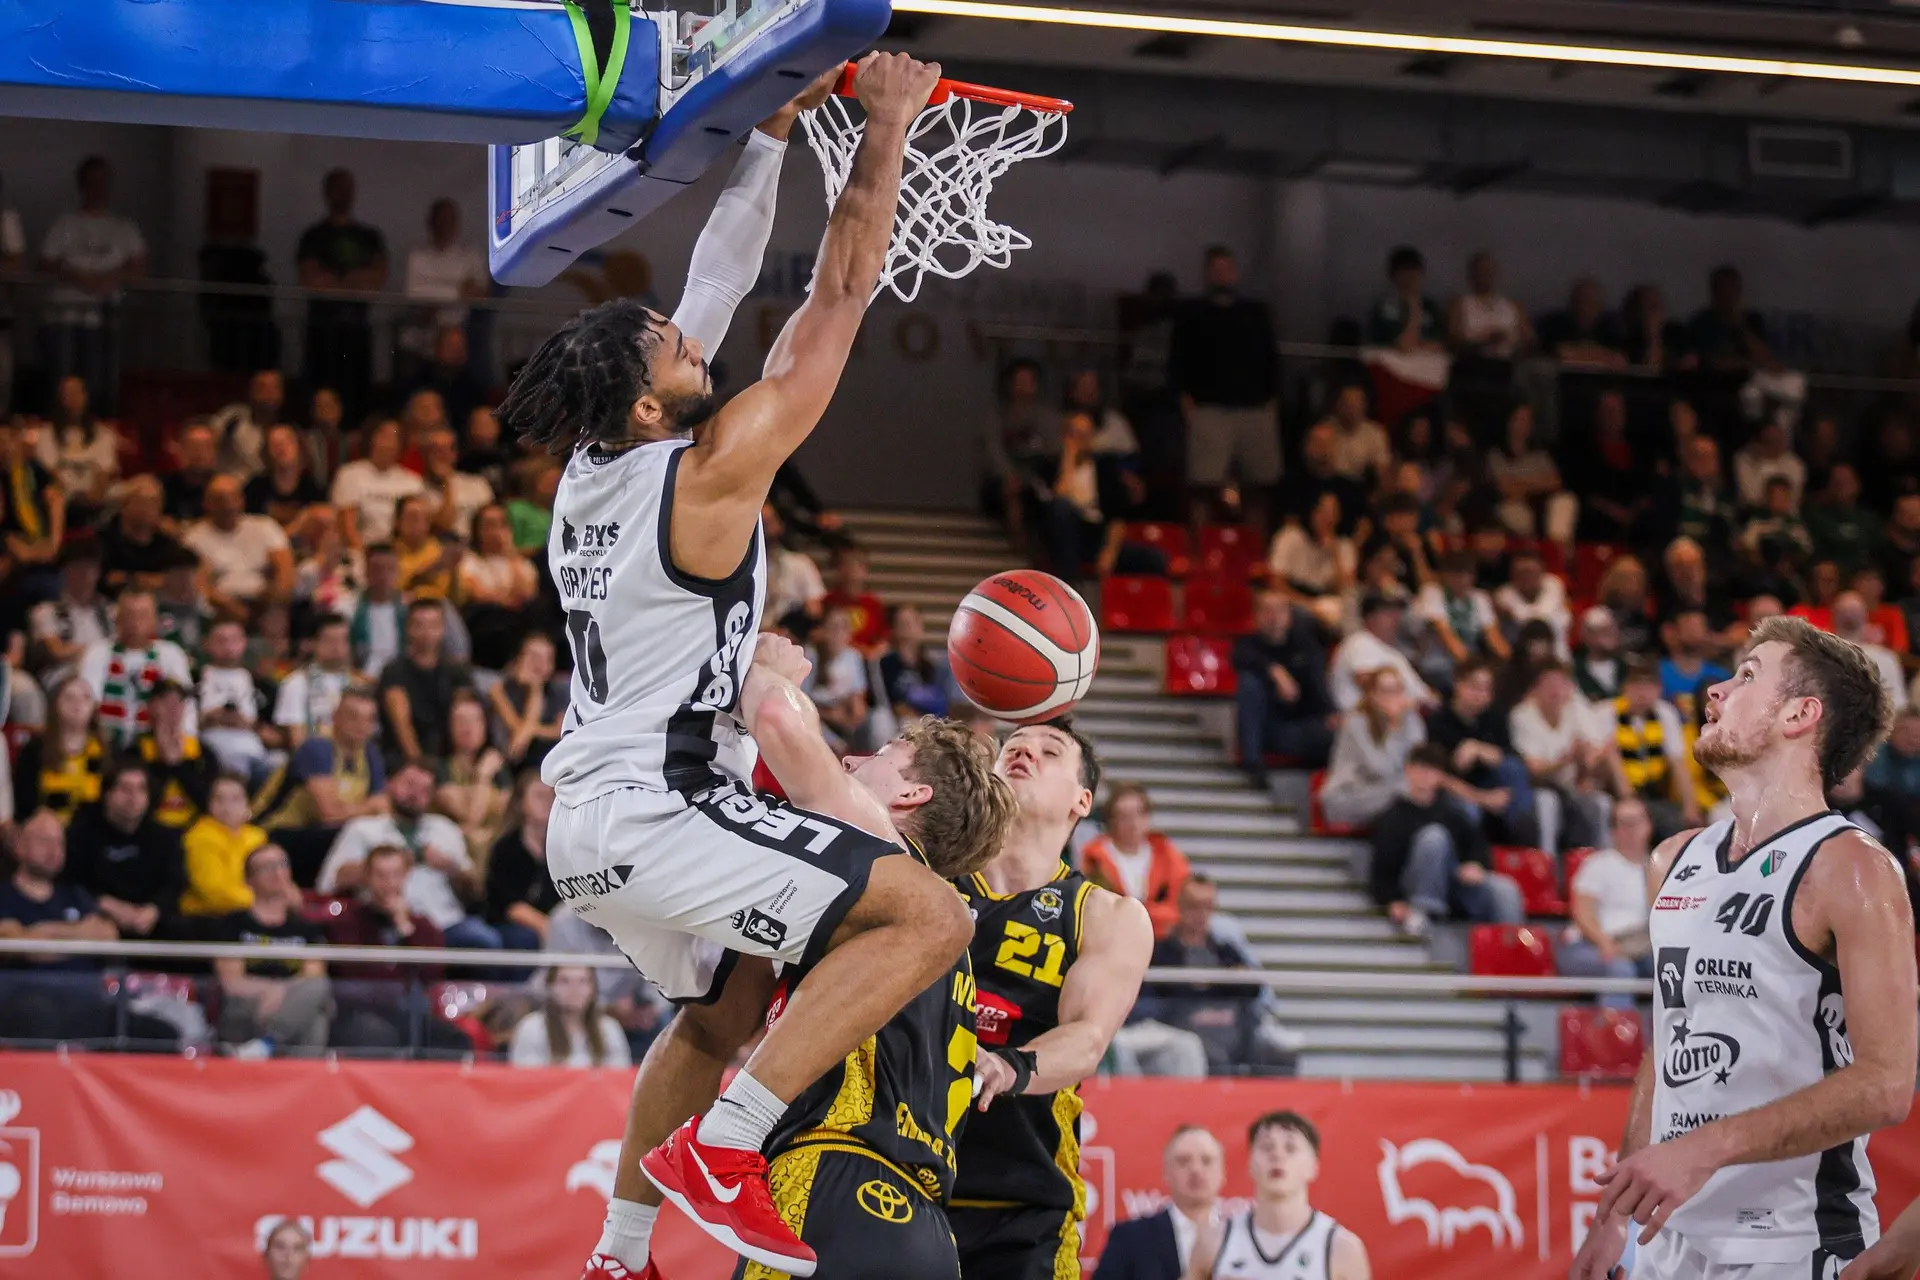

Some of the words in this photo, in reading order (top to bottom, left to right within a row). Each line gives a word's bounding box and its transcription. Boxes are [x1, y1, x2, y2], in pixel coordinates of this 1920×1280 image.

[768, 879, 794, 911] Warszawa
[775, 886, 798, 915] Bemowo
[1714, 891, 1775, 937] 40
[995, 920, 1066, 988] 21
[1694, 958, 1752, 980] ORLEN
[1694, 980, 1759, 999] TERMIKA
[1672, 1043, 1721, 1076] LOTTO
